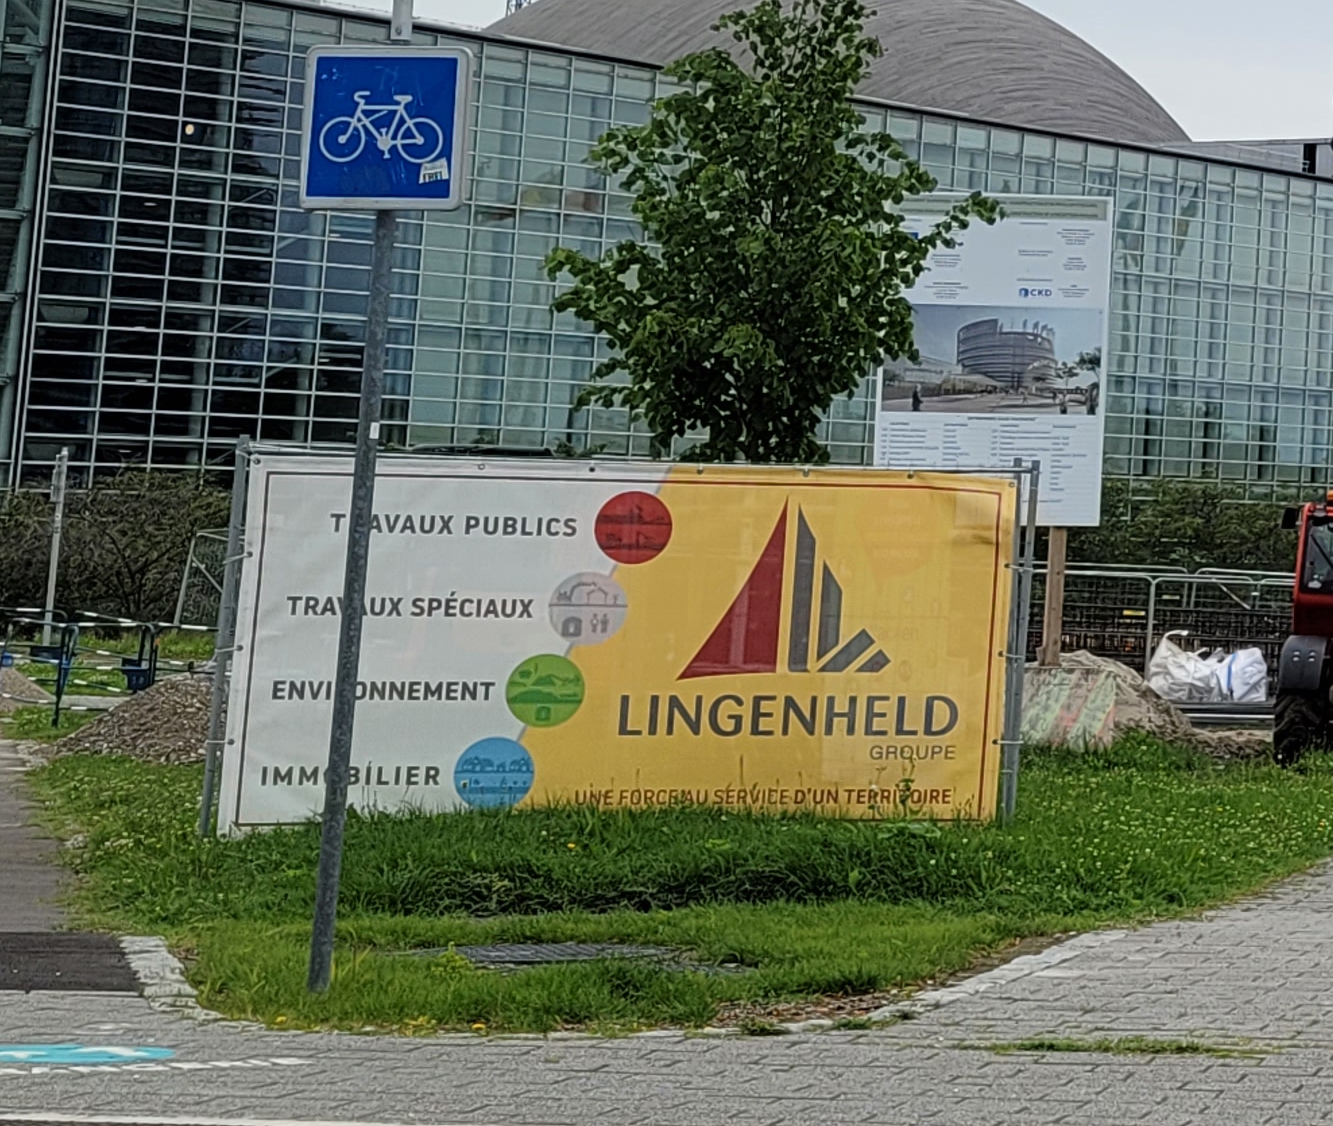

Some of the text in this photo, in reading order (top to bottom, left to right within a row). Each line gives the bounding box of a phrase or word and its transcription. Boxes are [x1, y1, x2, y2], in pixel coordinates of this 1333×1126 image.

[1030, 288, 1052, 297] CKD
[331, 513, 577, 537] TAVAUX PUBLICS
[287, 591, 533, 619] TRAUX SPÉCIAUX
[271, 680, 496, 701] ENVIONNEMENT
[617, 694, 959, 738] LINGENHELD
[870, 744, 957, 761] GROUPE
[260, 766, 441, 786] IMMBILIER
[575, 789, 614, 806] UNE
[618, 789, 678, 805] FORCE
[684, 789, 709, 805] AU
[713, 789, 790, 805] SERVICE
[793, 788, 839, 805] D'UN
